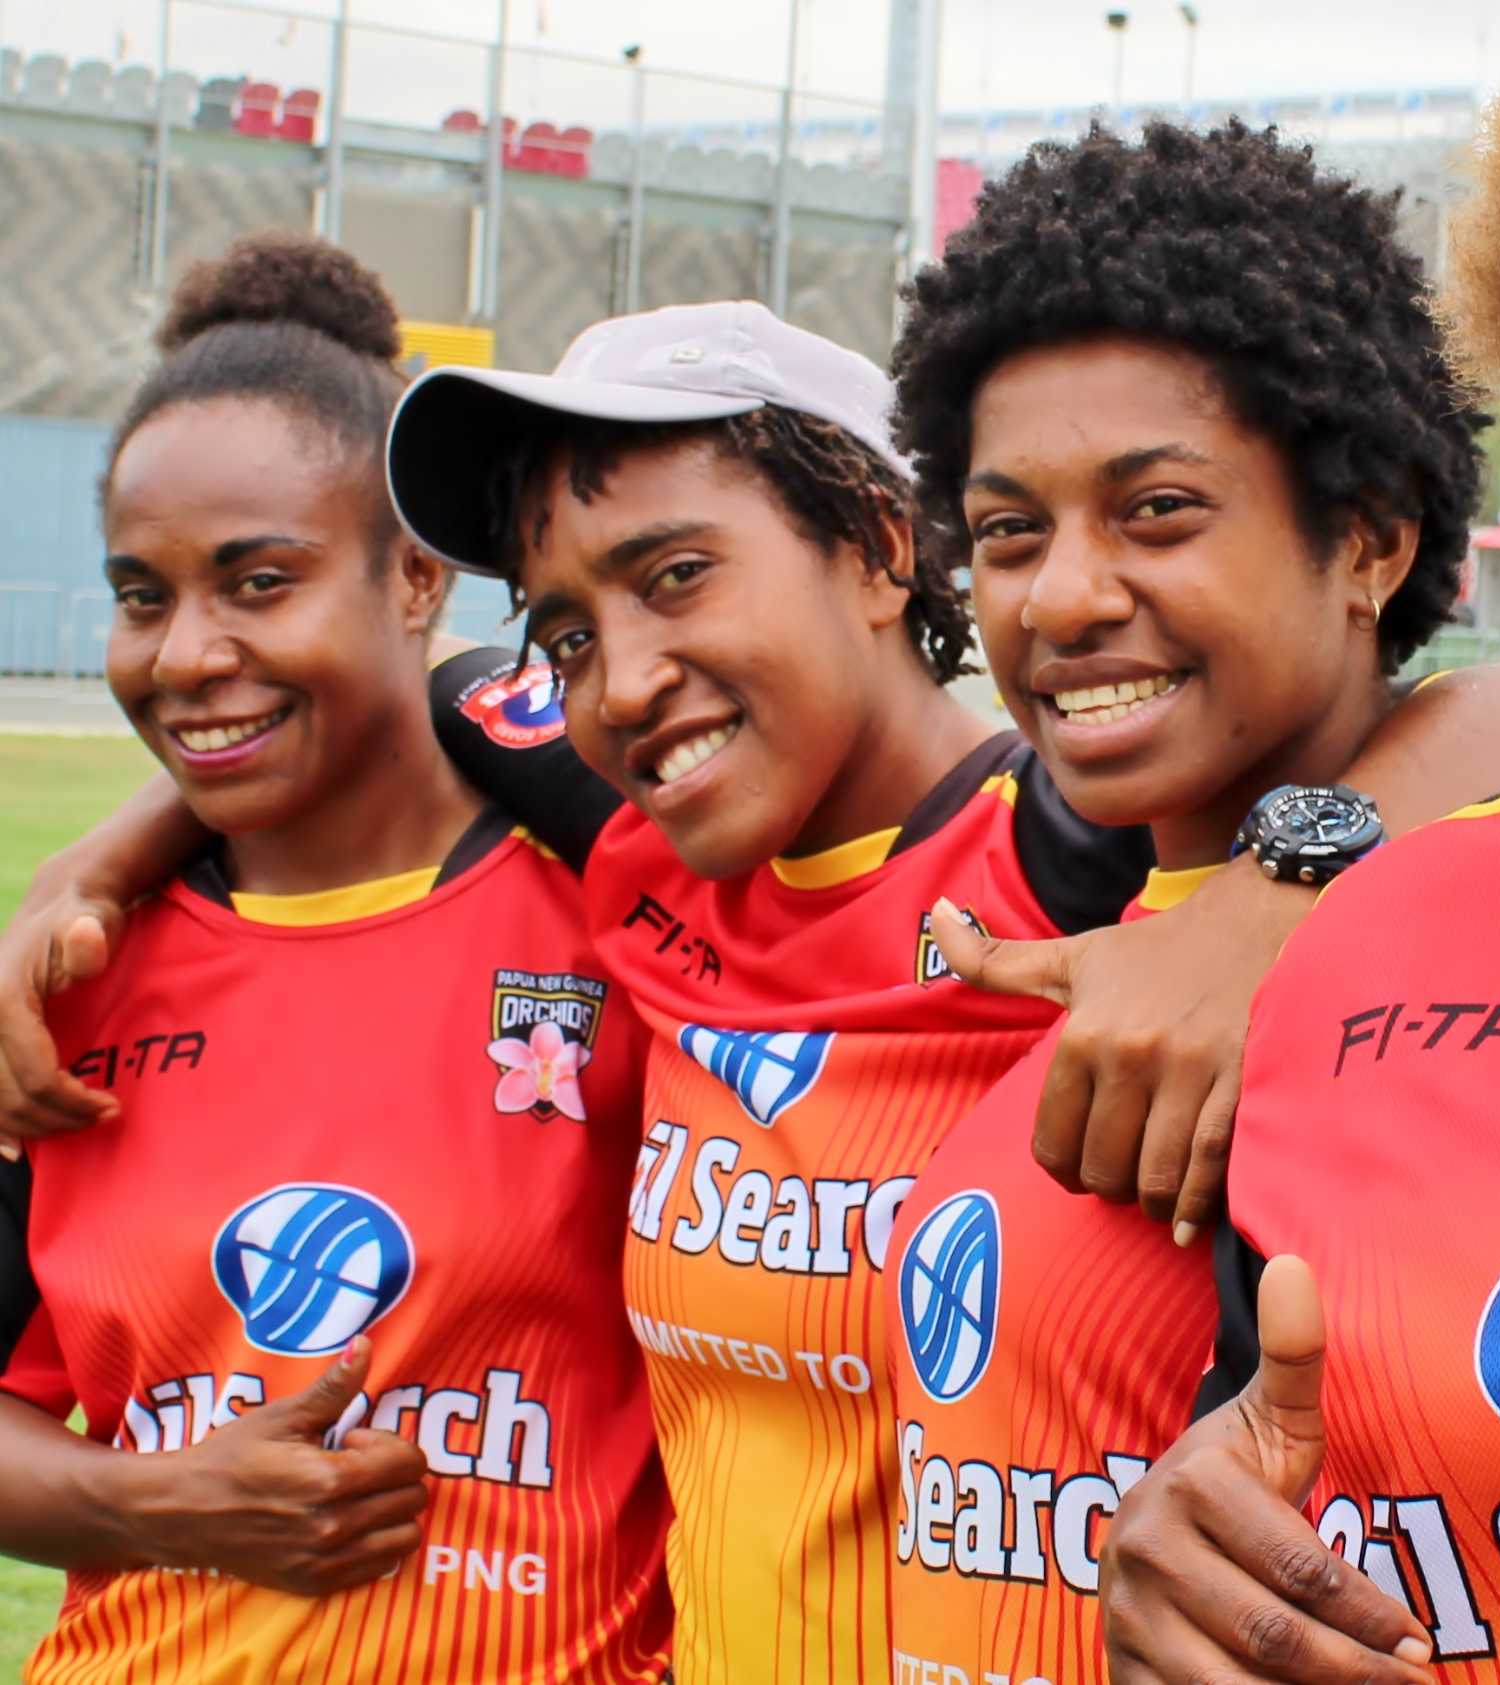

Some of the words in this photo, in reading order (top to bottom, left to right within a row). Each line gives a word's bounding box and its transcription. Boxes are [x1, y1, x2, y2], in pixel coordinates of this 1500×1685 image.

[497, 970, 537, 989] PAPUA
[538, 975, 562, 991] NEW
[501, 996, 593, 1038] ORCHIDS
[671, 1135, 917, 1276] Searc
[796, 1350, 871, 1394] TO
[896, 1419, 1152, 1596] Searc
[423, 1543, 548, 1596] PNG
